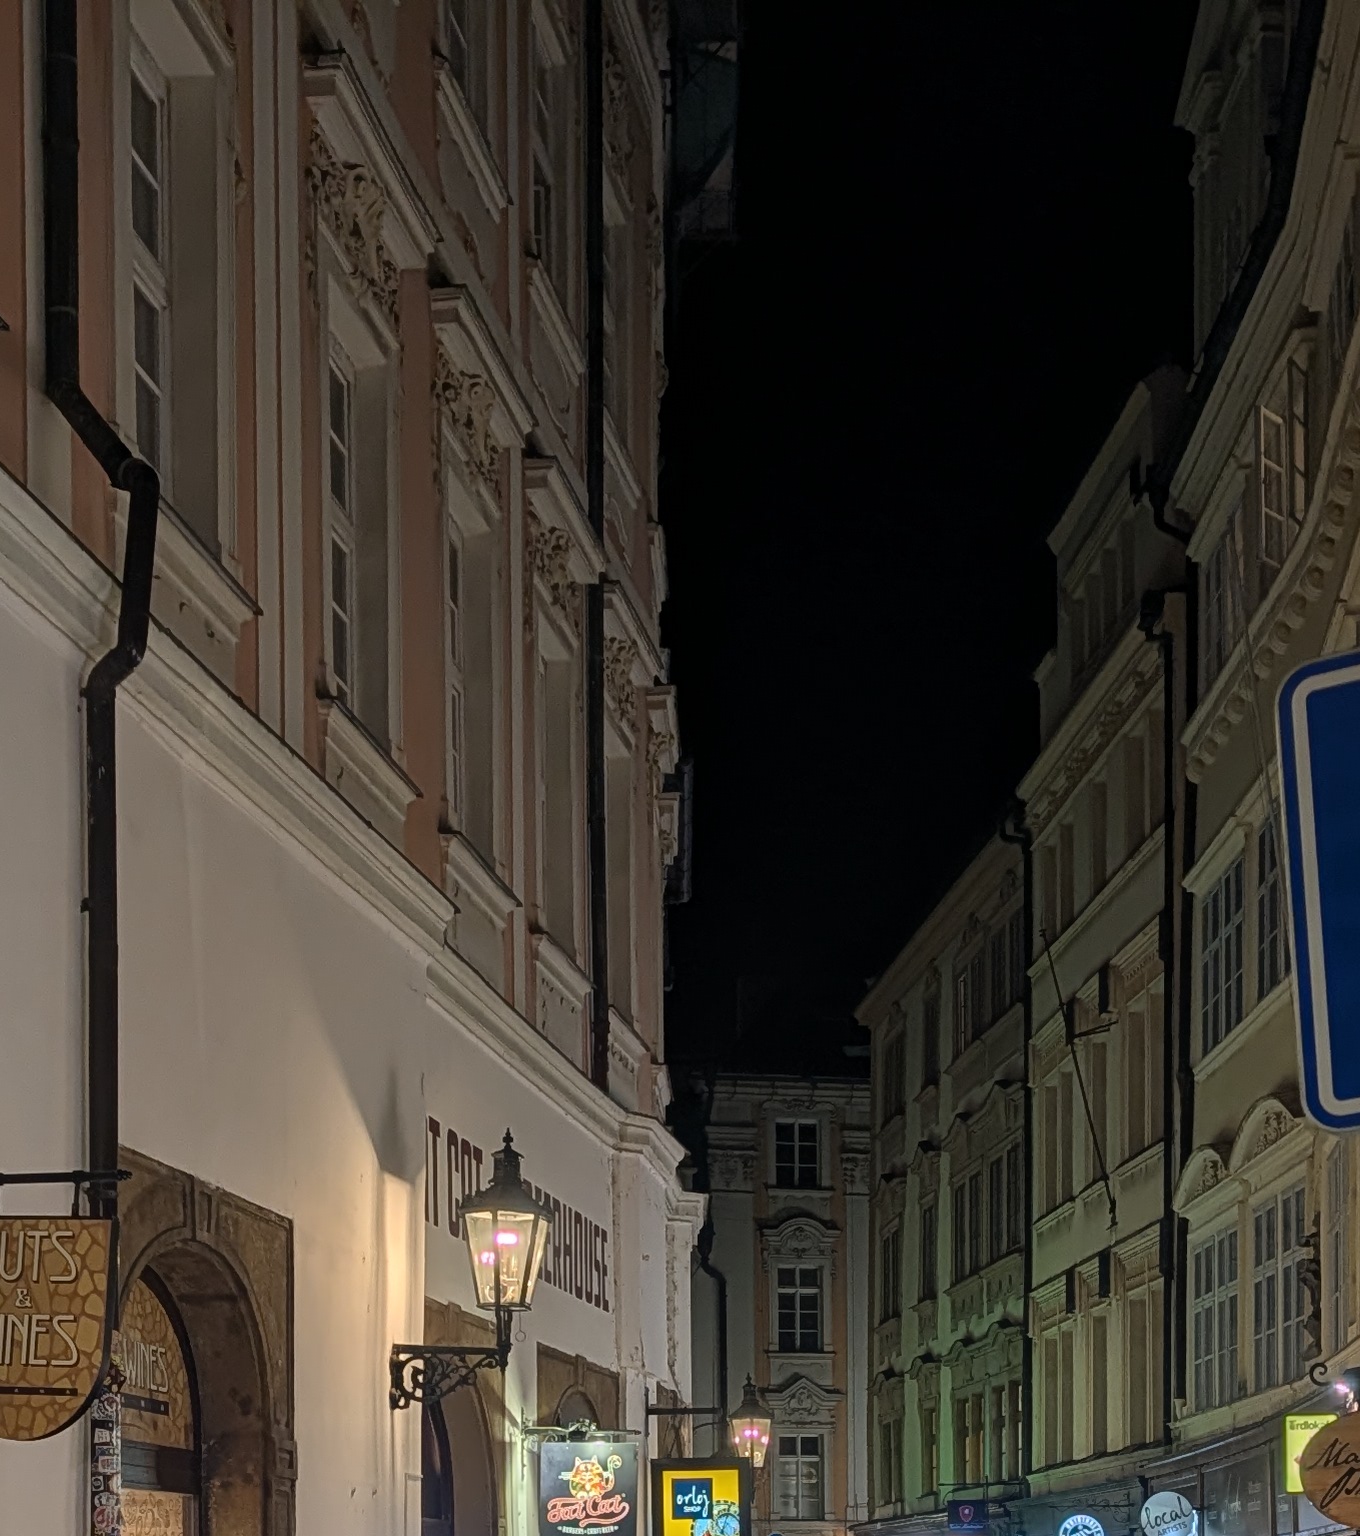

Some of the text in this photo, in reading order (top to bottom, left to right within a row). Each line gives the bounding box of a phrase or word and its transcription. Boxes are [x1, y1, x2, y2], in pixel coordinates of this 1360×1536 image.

[15, 1288, 33, 1308] &
[123, 1338, 169, 1393] WINES
[676, 1485, 710, 1518] orloj
[683, 1505, 702, 1513] SHOP
[1142, 1496, 1192, 1531] local
